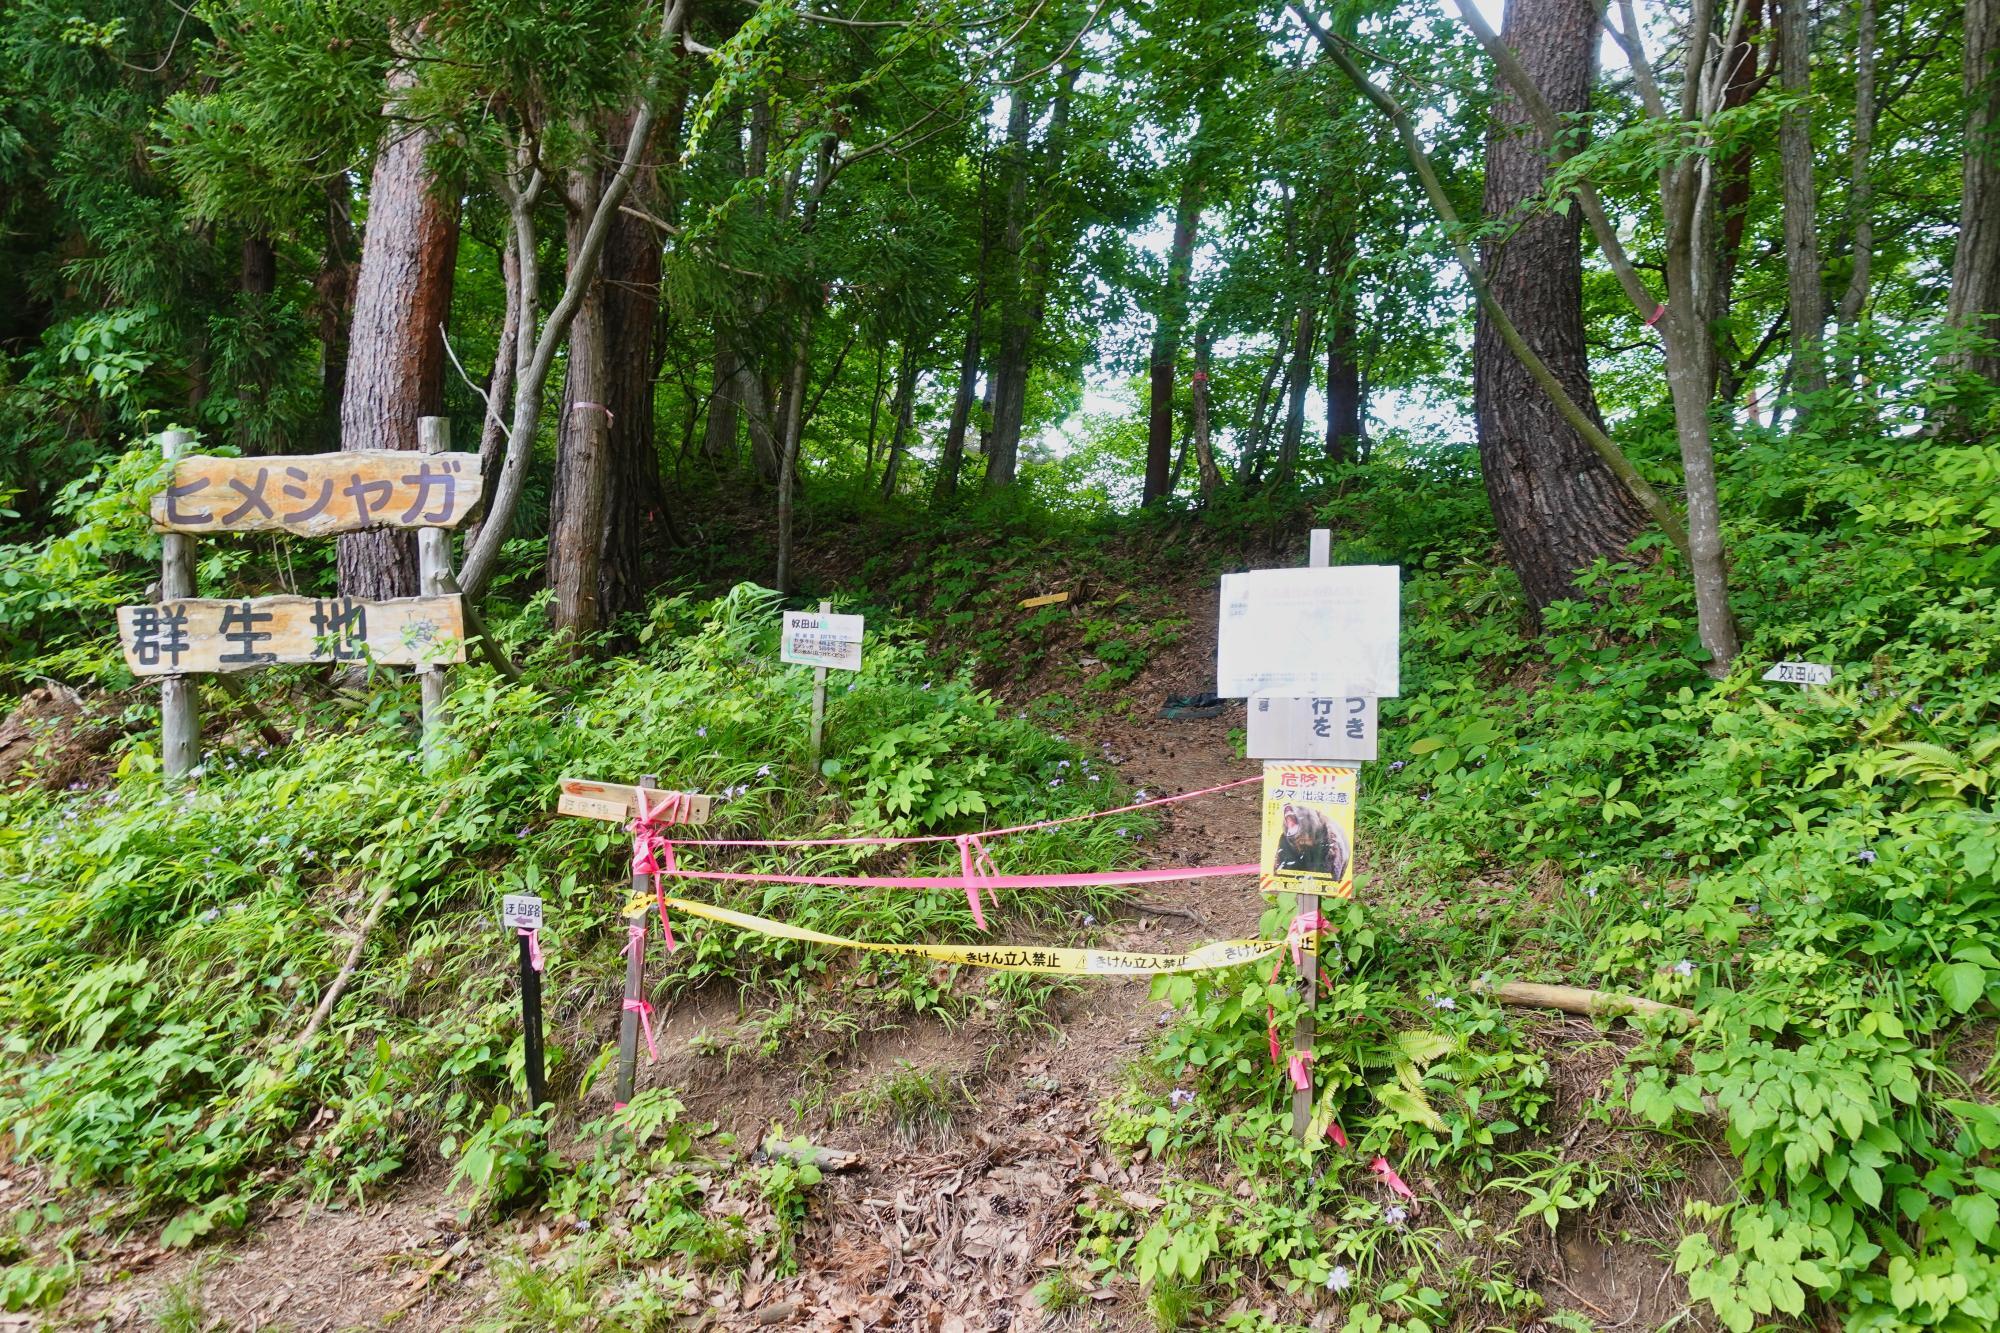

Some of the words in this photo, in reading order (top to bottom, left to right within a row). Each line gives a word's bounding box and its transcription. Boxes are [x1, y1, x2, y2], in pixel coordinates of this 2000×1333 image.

[167, 460, 460, 526] ヒメシャガ
[131, 597, 367, 666] 群生地
[966, 951, 1062, 968] きけん立入禁止
[1095, 954, 1191, 970] きけん立入禁止
